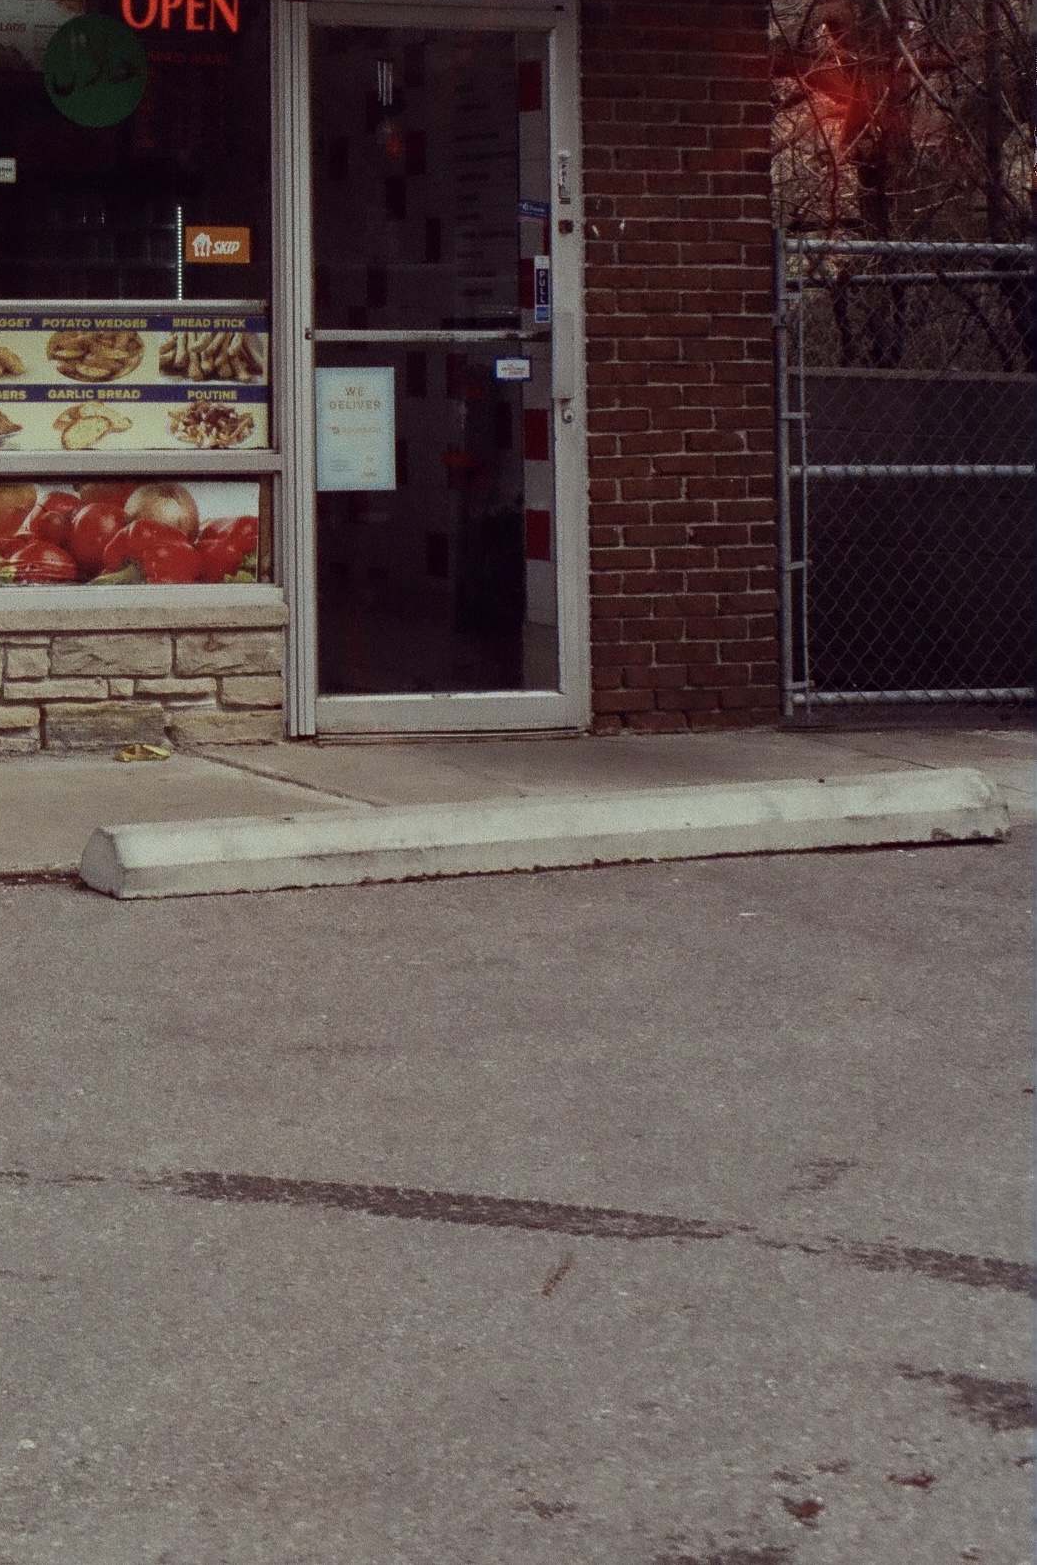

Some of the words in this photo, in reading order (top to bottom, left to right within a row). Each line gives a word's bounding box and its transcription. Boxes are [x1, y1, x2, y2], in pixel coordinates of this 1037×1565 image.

[212, 240, 241, 255] SKIP
[538, 270, 547, 303] PULL
[42, 318, 91, 328] POTATO
[94, 318, 147, 328] WEDGES
[172, 318, 210, 328] BREAD
[214, 318, 246, 328] STICK
[47, 389, 95, 400] GARLIC
[98, 390, 141, 400] BREAD
[187, 390, 237, 400] POUTINE
[345, 386, 364, 396] WE
[329, 400, 381, 410] DELIVER
